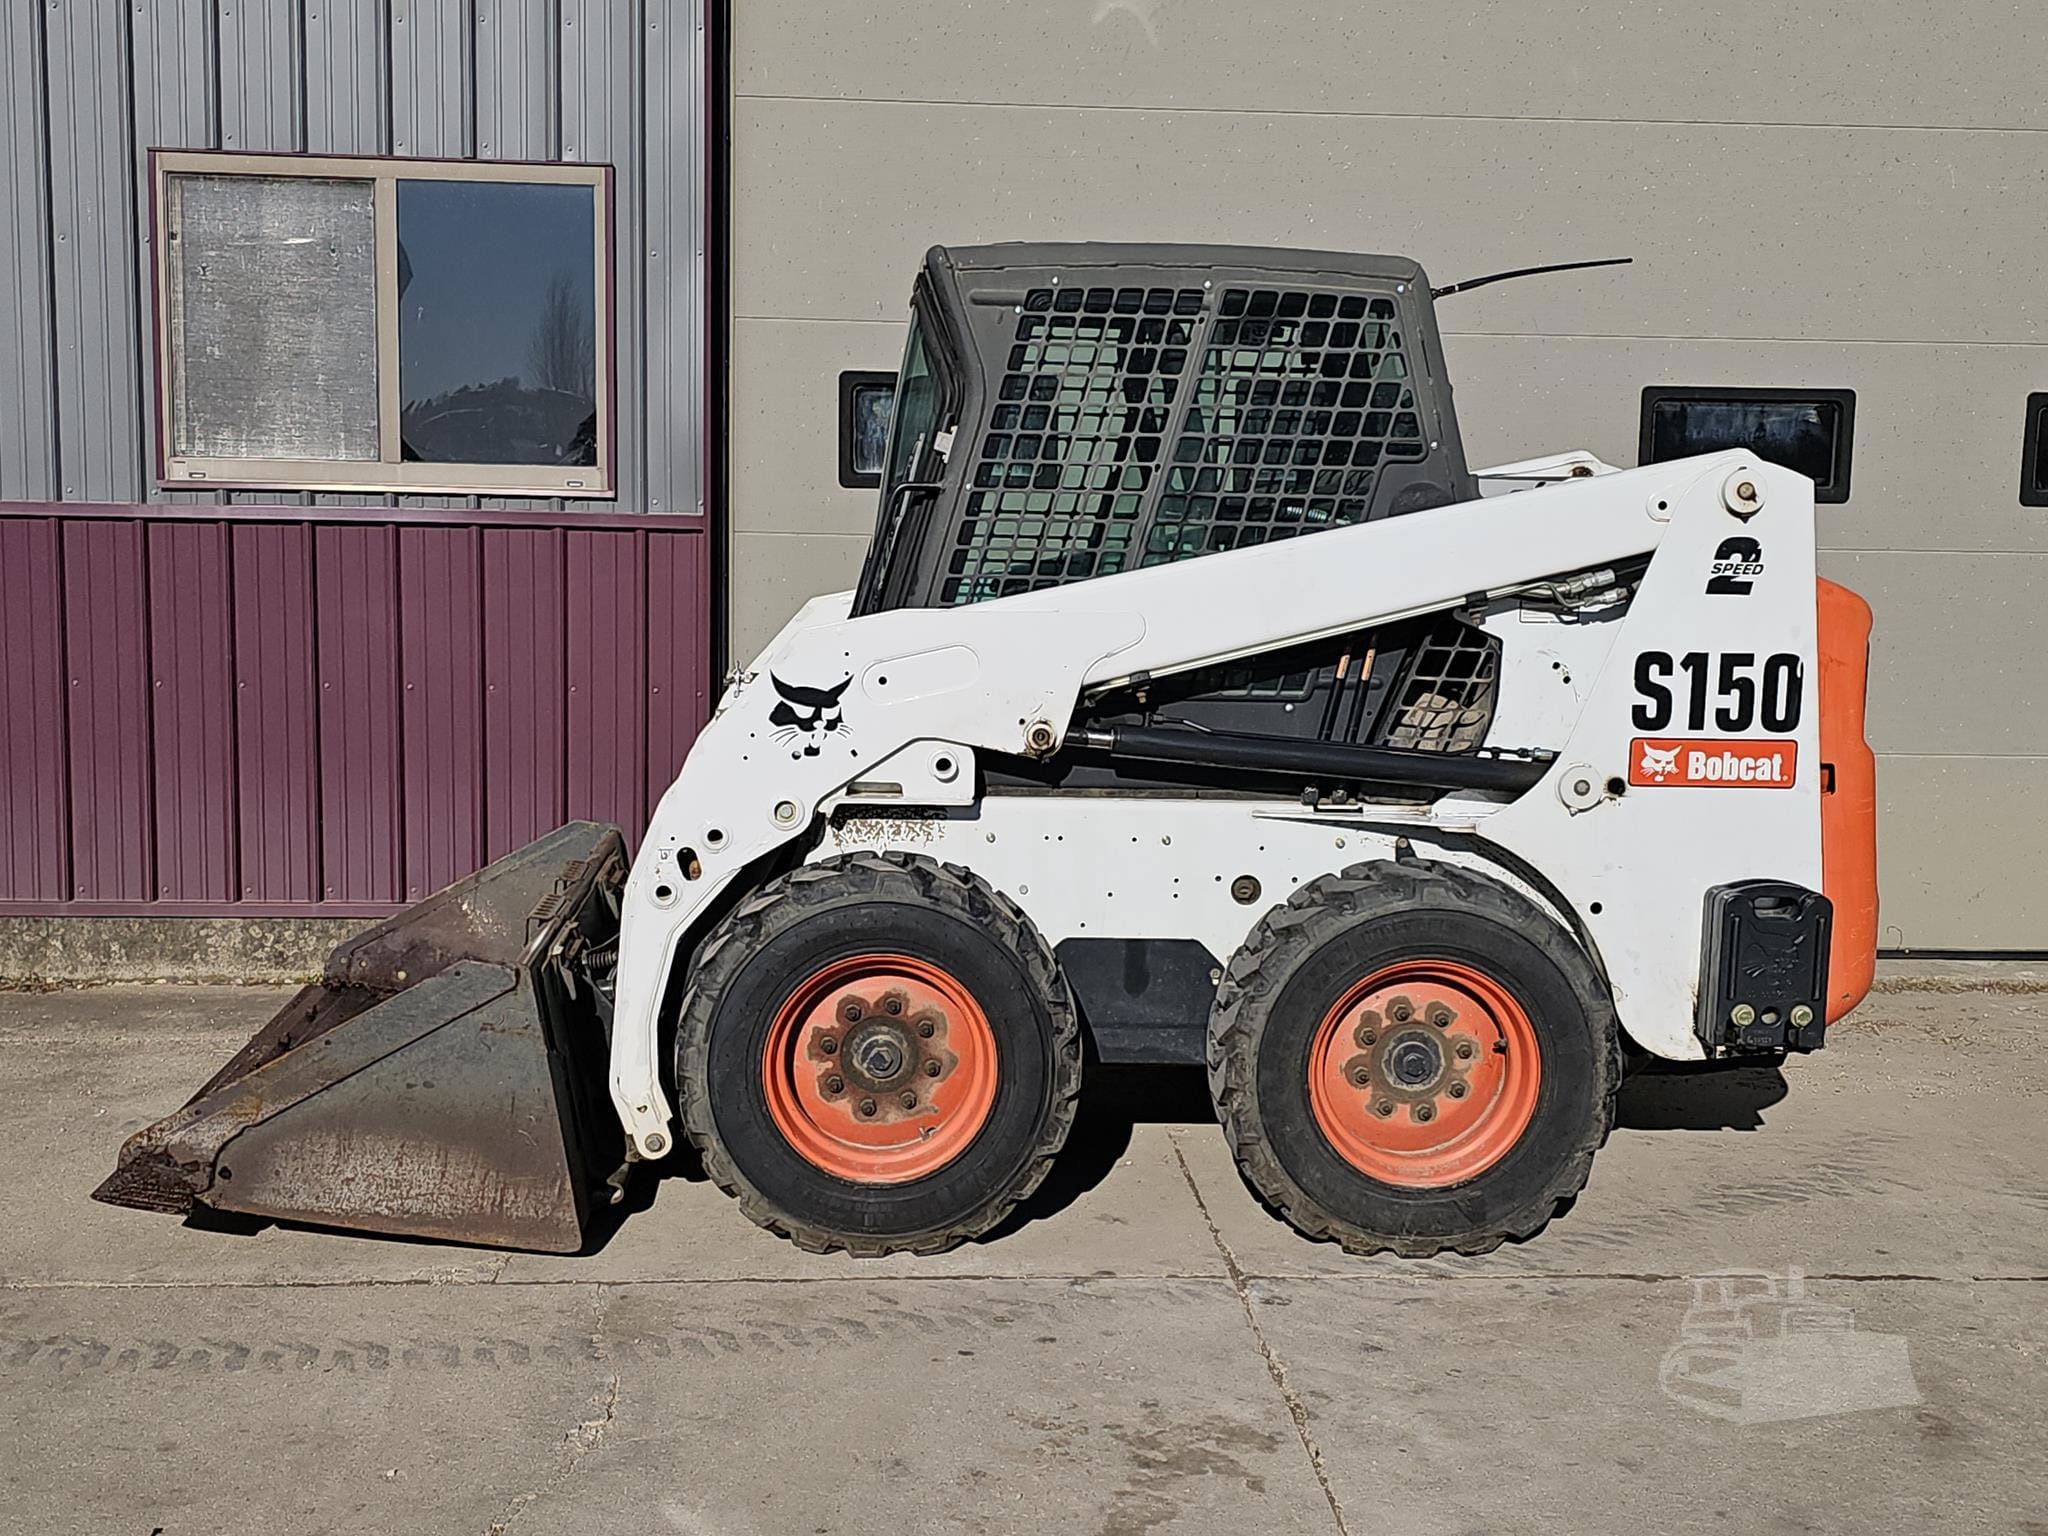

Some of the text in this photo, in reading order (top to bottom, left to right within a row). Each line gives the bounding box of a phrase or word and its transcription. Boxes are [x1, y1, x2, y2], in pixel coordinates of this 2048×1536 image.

[1705, 536, 1762, 595] 2
[1710, 562, 1764, 575] SPEED
[1631, 651, 1804, 733] S150
[1687, 751, 1783, 782] Bobcat
